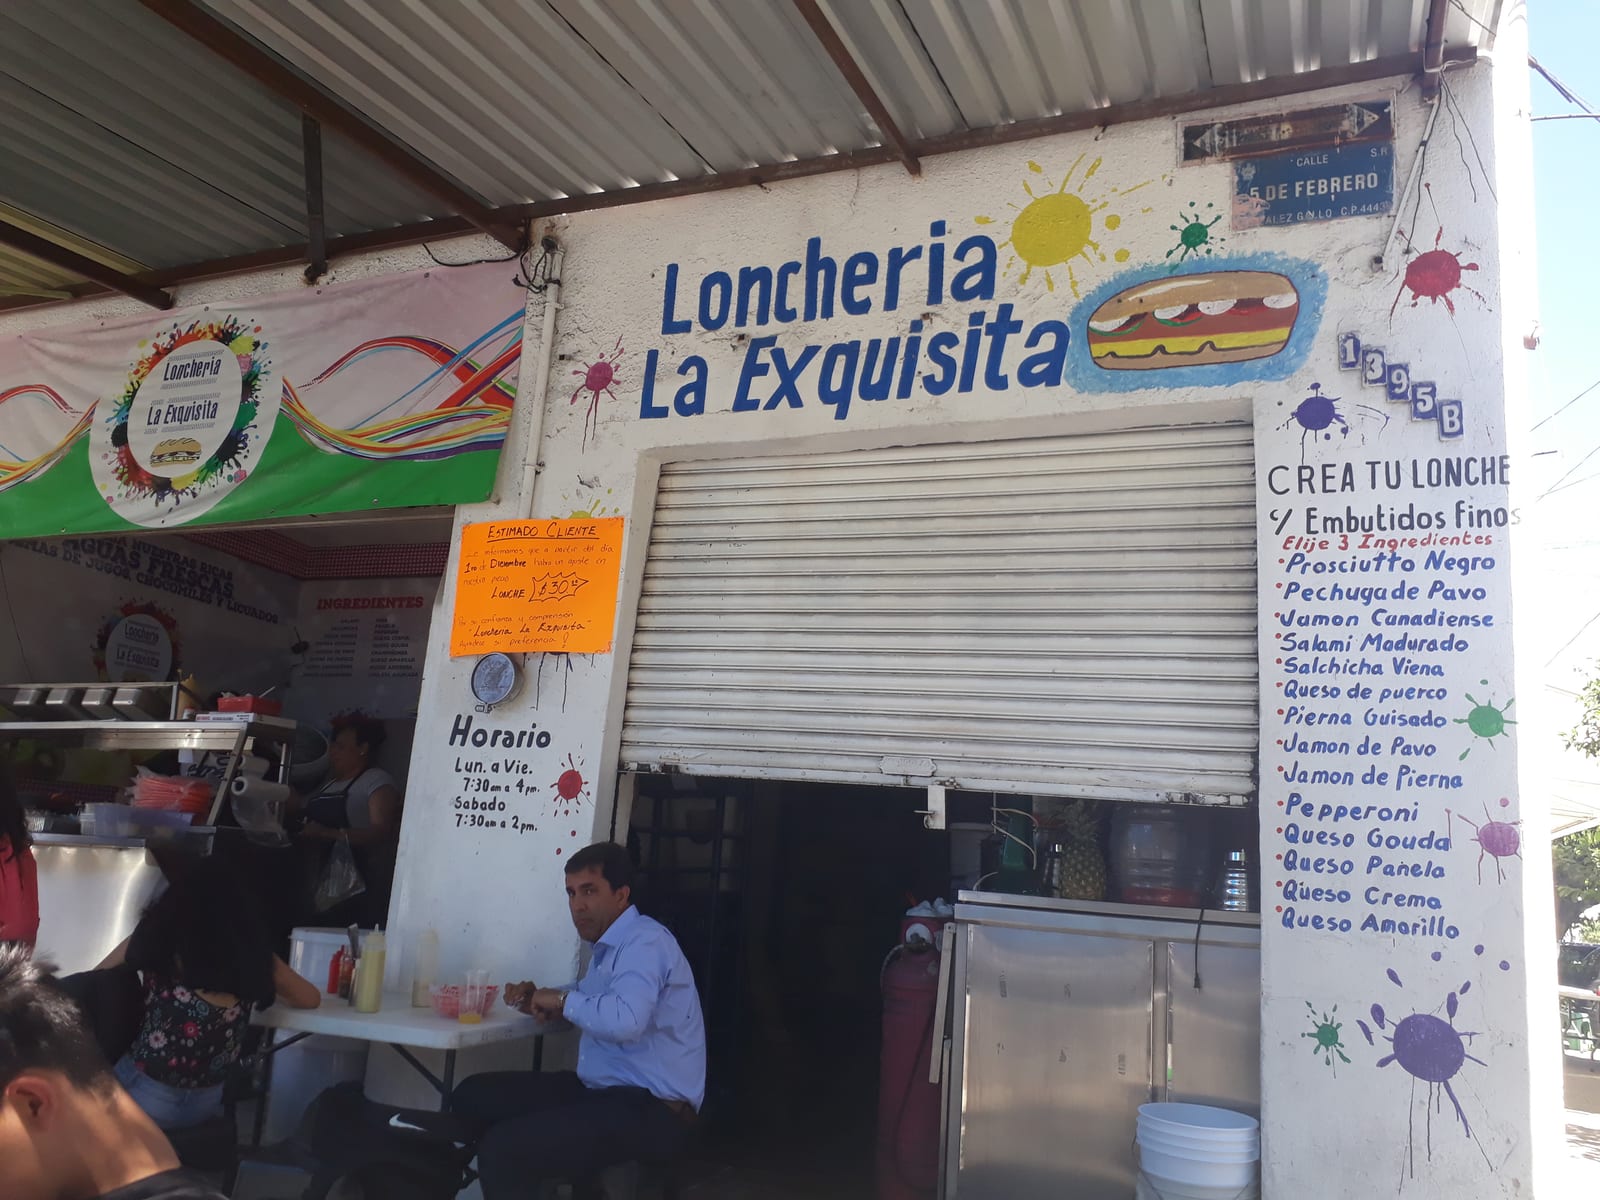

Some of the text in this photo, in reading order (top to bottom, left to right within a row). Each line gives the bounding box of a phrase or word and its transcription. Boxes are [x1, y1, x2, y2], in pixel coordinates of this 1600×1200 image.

[1296, 154, 1328, 167] CALLE
[1250, 172, 1378, 201] 5 DE FEBRERO
[661, 220, 997, 335] Loncheria
[163, 356, 222, 381] Loncheria
[639, 303, 1071, 420] La Exquisita
[147, 400, 219, 426] La Exquisita
[1268, 455, 1510, 495] CREA TU LONCHE
[488, 522, 597, 539] ESTIMADO CLIENTE
[1306, 503, 1446, 535] Embutidos
[1282, 530, 1493, 554] Elije 3 Ingredientes
[199, 562, 233, 581] RICAS
[1285, 550, 1496, 576] Prosciutto Negro
[147, 556, 234, 599] FRESCAS
[216, 597, 224, 607] Y
[317, 596, 424, 610] INGREDIENTES
[491, 586, 526, 599] LONCHE
[1284, 580, 1486, 606] Pechuga de Pavo
[1280, 608, 1494, 627] Jamon Canadiense
[1280, 631, 1469, 652] Salami Madurado
[1284, 656, 1445, 677] Salchicha Viena
[1284, 679, 1447, 703] Queso de puerco
[1284, 705, 1447, 728] Pierna Guisado
[449, 713, 551, 749] Horario
[1283, 732, 1437, 757] Jamon de Pavo
[455, 757, 533, 775] Lun. a Vie.
[1283, 760, 1463, 791] Jamon de Pierna
[505, 784, 510, 793] a
[455, 796, 506, 811] Sabado
[1285, 792, 1419, 823] Pepperoni
[500, 819, 506, 828] a
[1284, 822, 1450, 851] Queso Gouda
[1283, 849, 1354, 875] Queso
[1283, 879, 1442, 910] Queso Crema
[1281, 907, 1459, 939] Queso Amarillo
